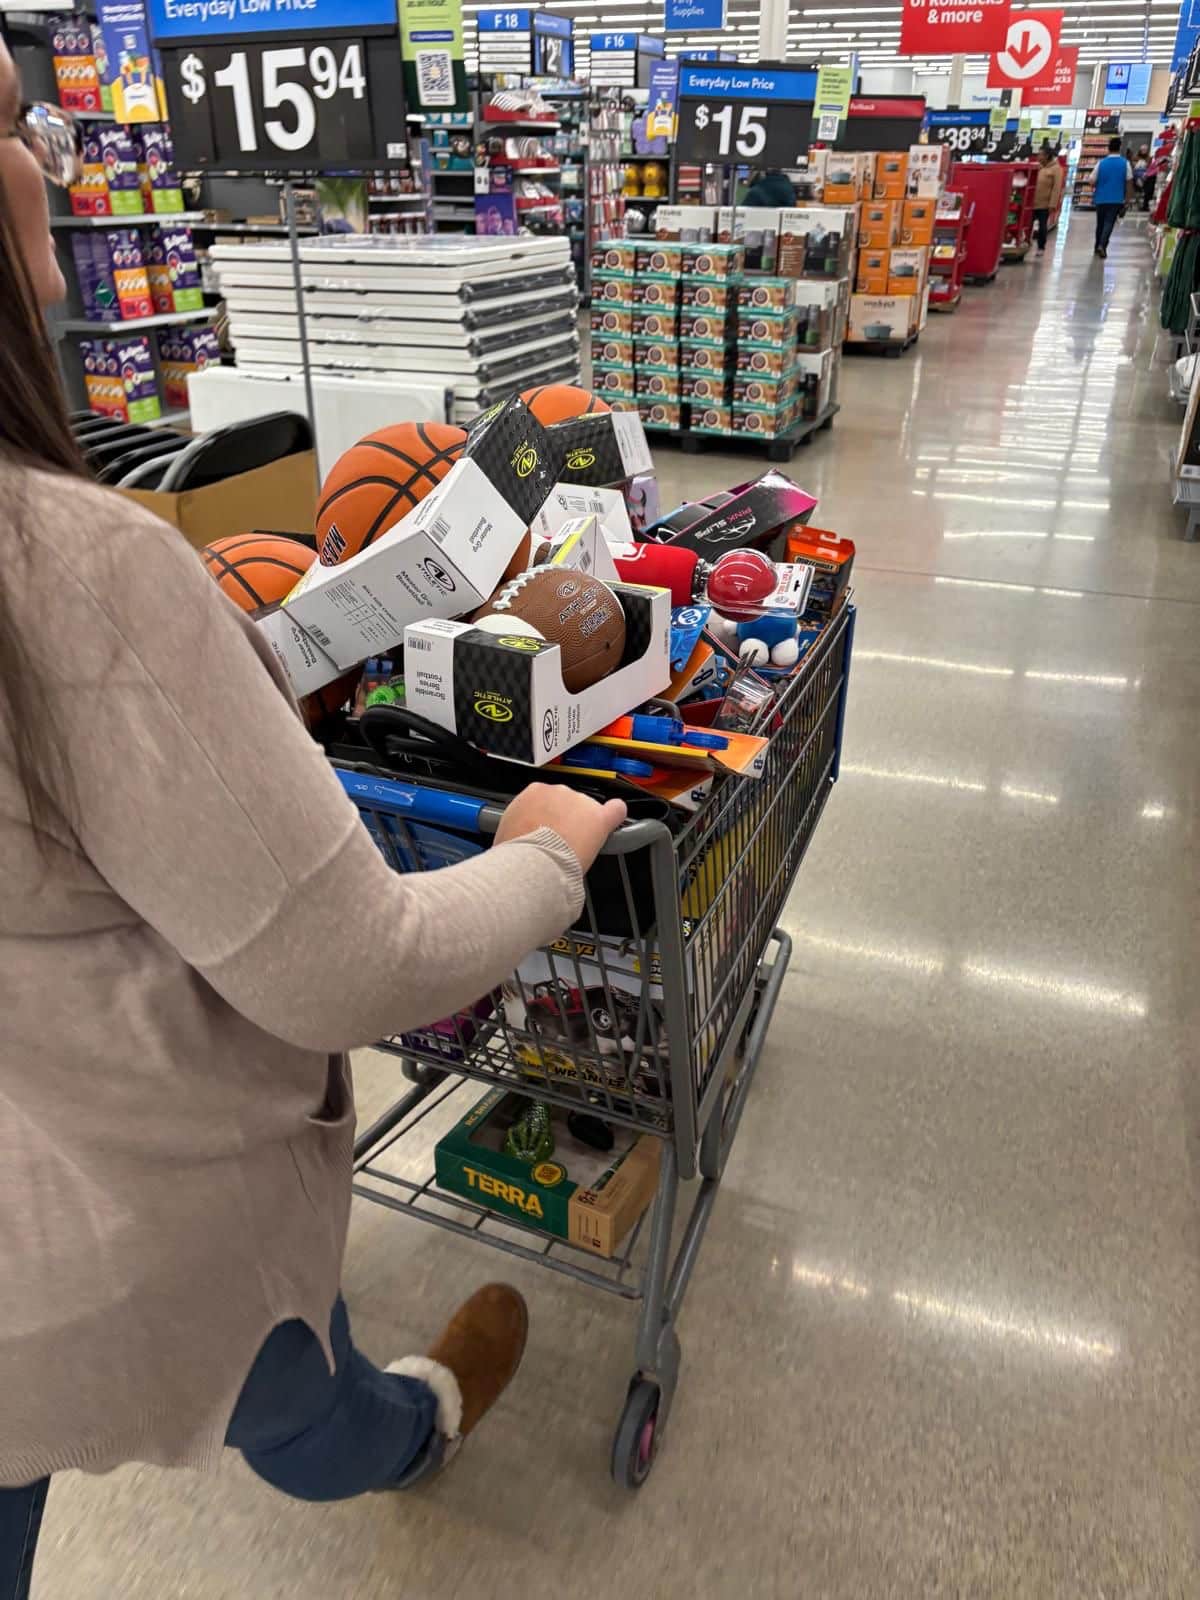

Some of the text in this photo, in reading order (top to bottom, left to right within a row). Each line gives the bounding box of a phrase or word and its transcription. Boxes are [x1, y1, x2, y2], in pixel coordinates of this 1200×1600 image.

[165, 0, 237, 20] Everyday
[240, 0, 272, 13] Low
[940, 10, 983, 23] more
[689, 75, 729, 90] Everyday
[731, 77, 750, 89] Low
[751, 78, 775, 90] Price
[474, 690, 513, 705] ATHLETIC
[463, 1166, 544, 1218] TERRA
